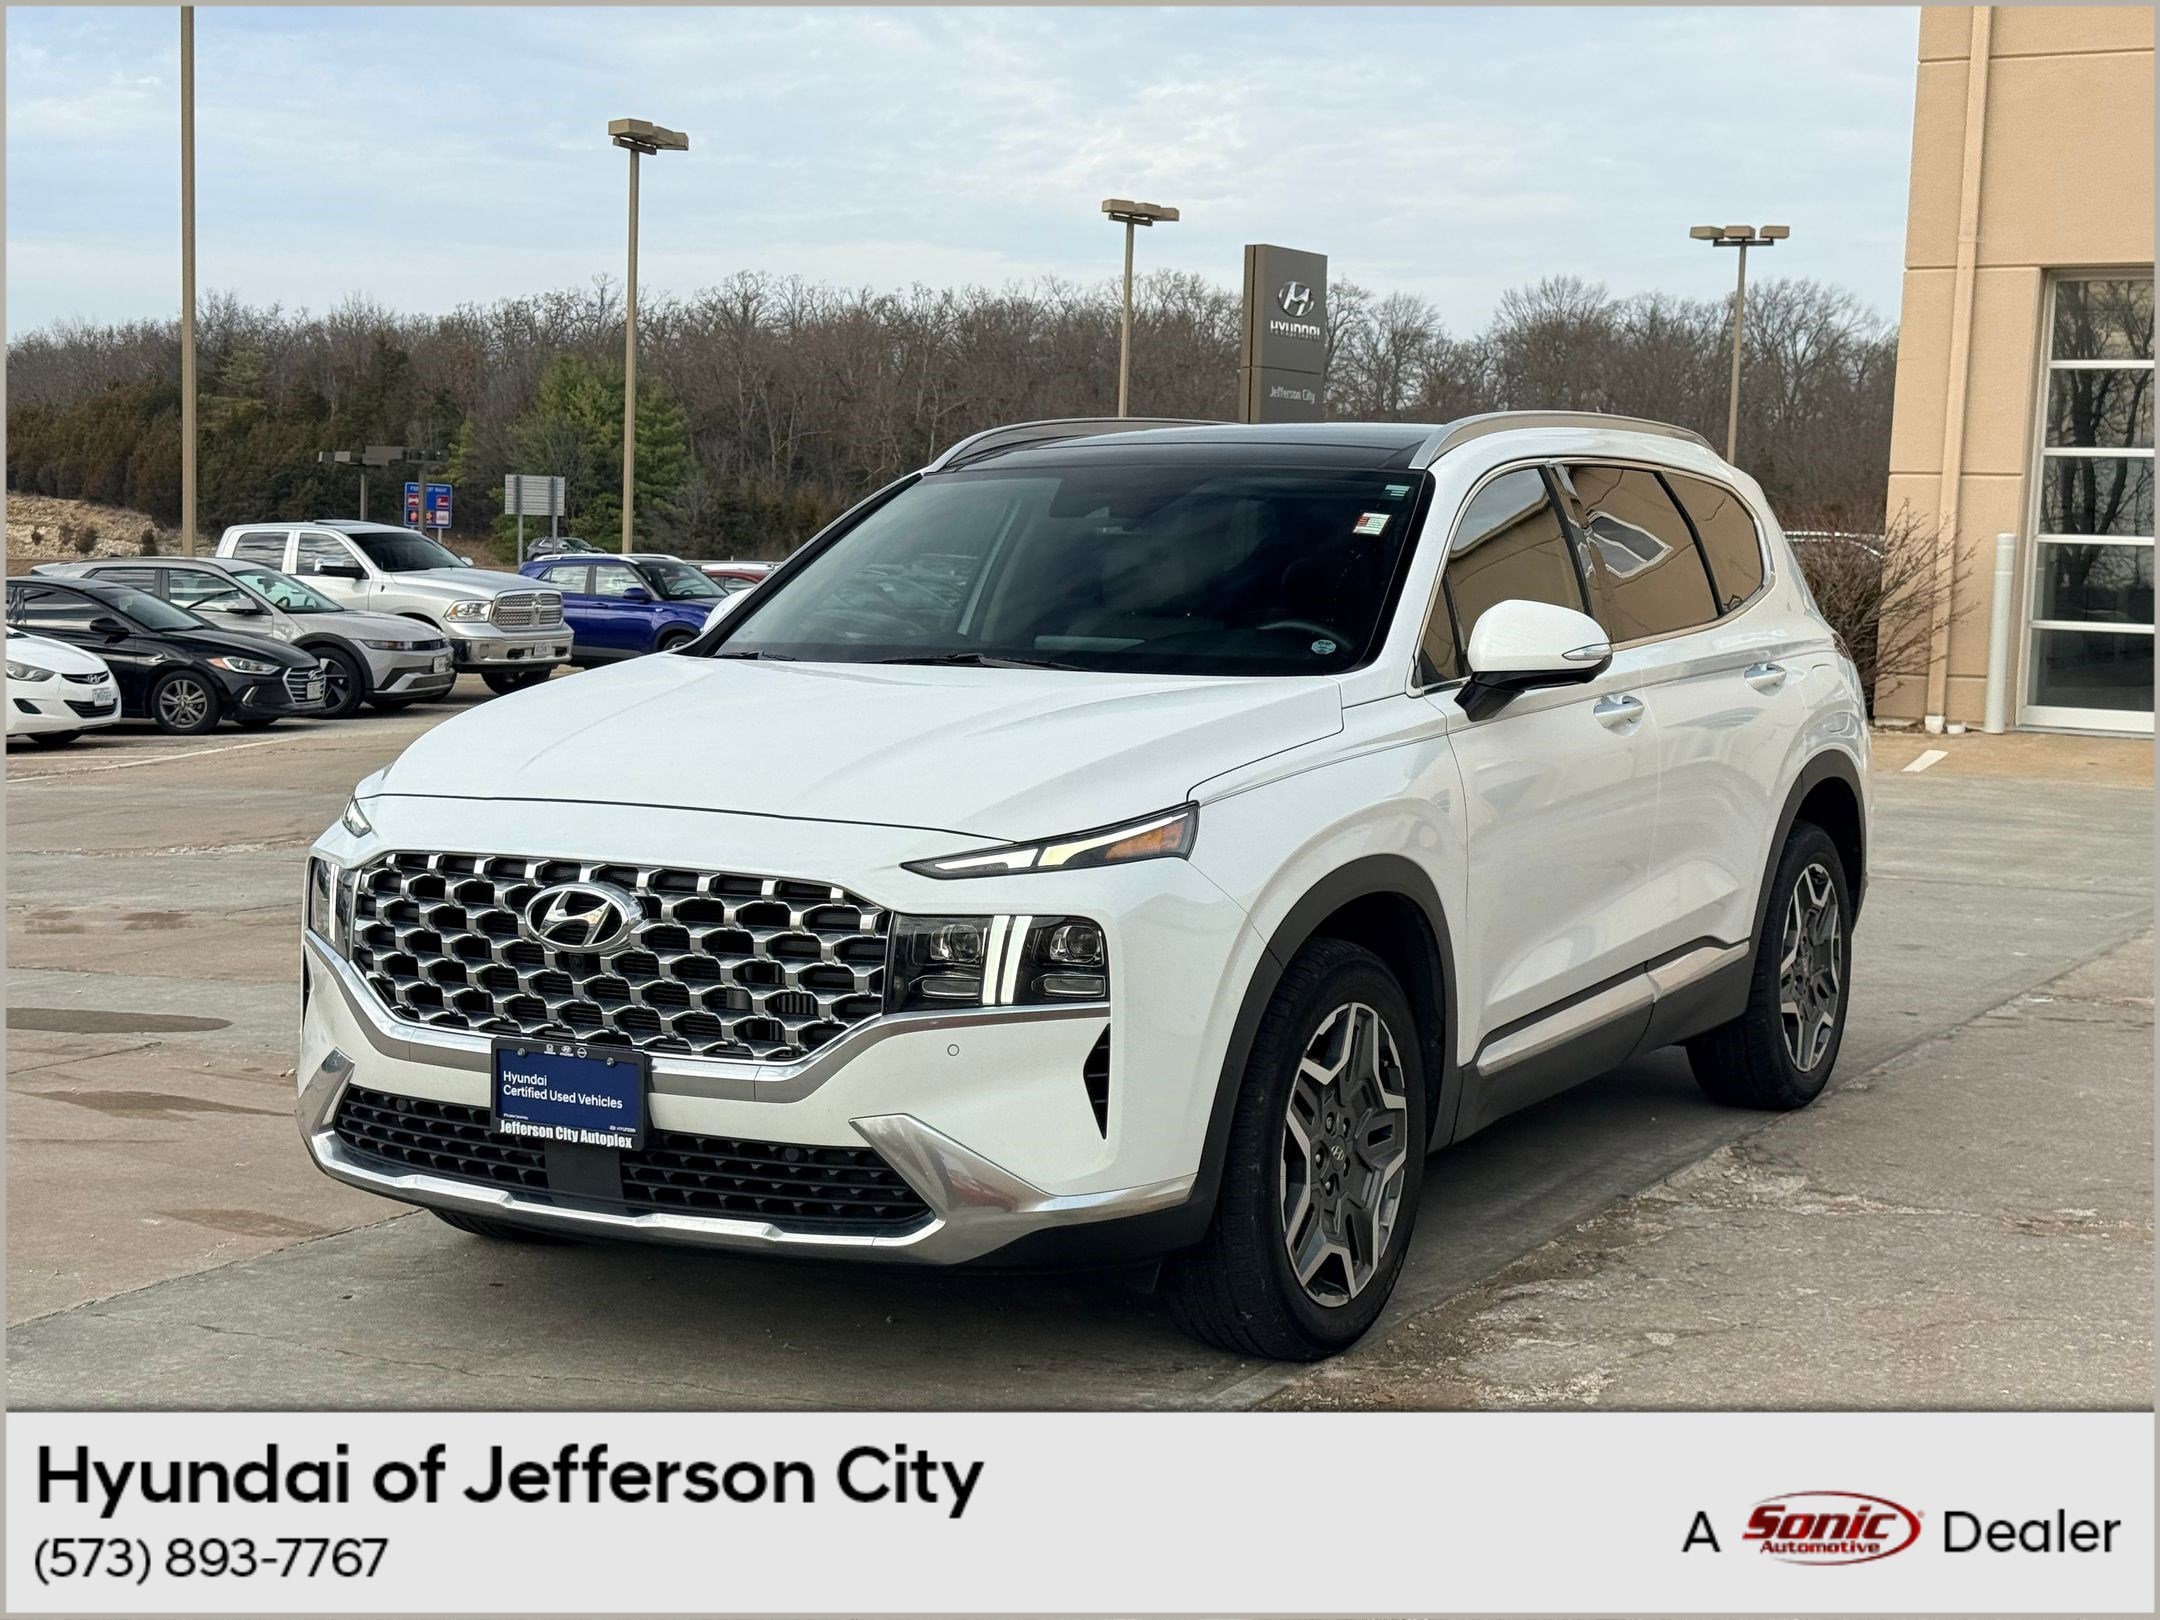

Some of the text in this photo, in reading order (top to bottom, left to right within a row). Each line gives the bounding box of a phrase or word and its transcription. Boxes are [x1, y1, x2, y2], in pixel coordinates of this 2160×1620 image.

[1269, 319, 1321, 338] HYUNDAI
[1269, 385, 1316, 404] Jefferson City
[503, 1070, 547, 1086] Hyundai
[503, 1084, 623, 1109] Certified Used Vehicles
[500, 1119, 633, 1149] Jefferson City Autoplex
